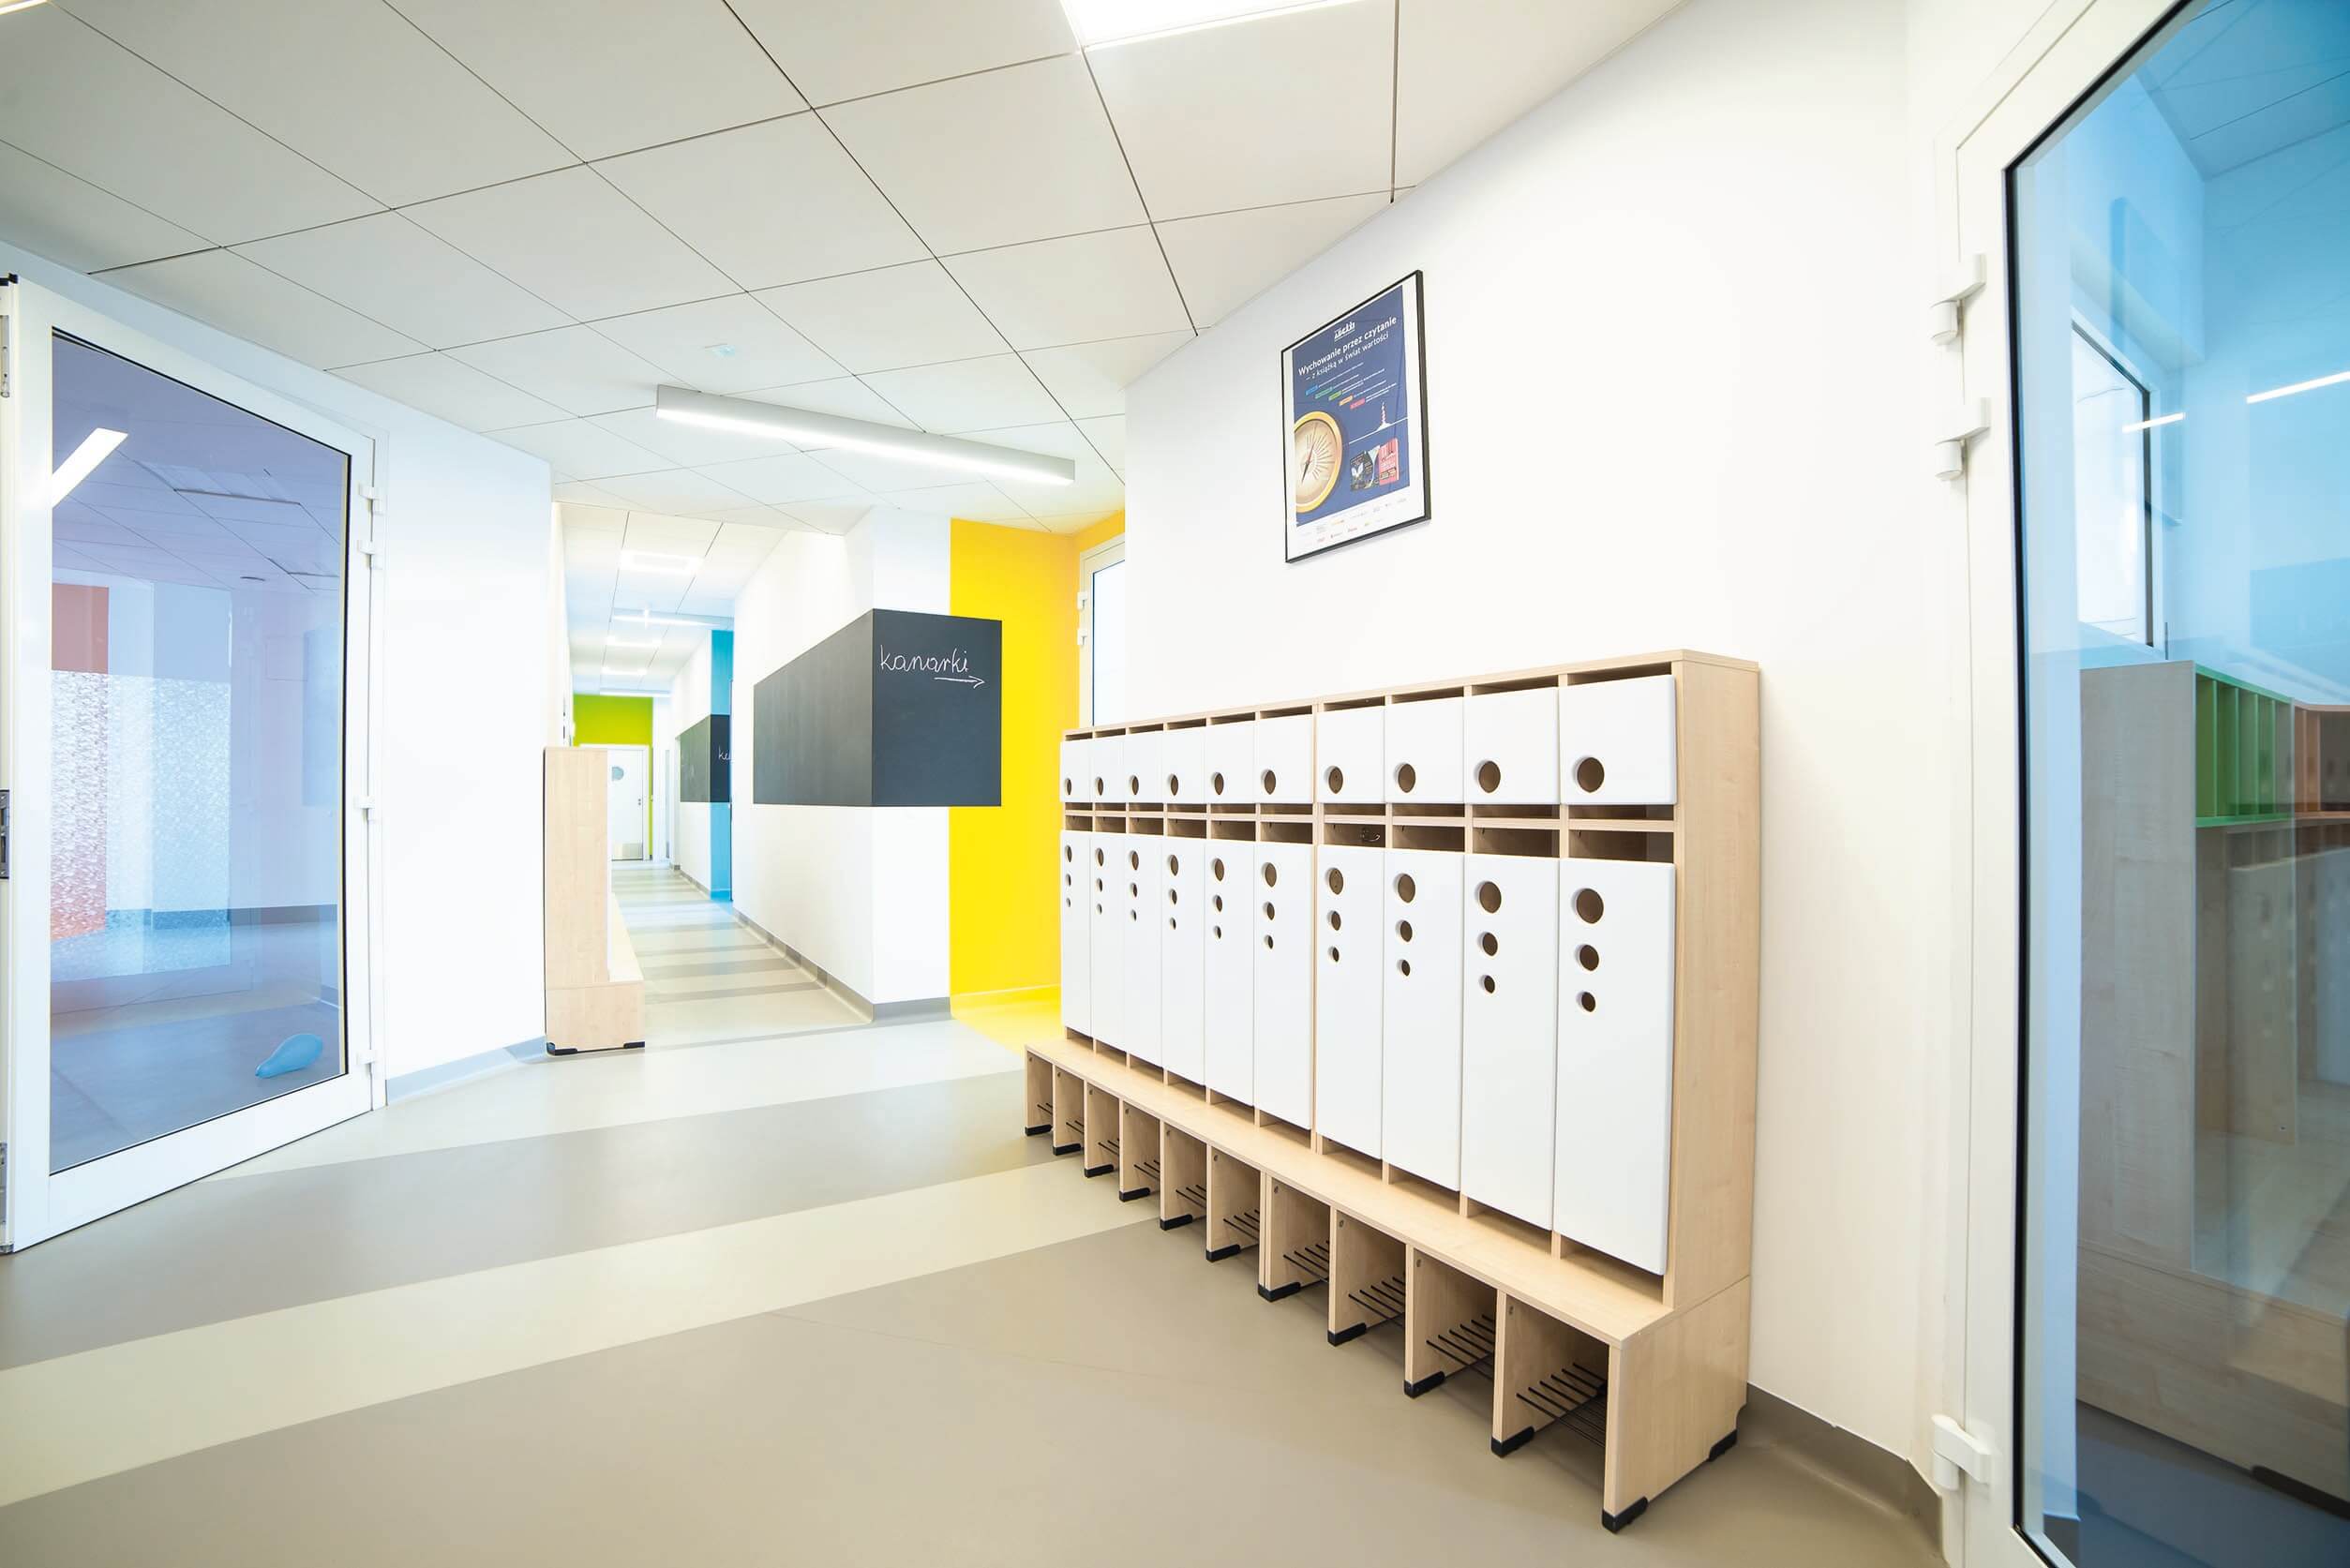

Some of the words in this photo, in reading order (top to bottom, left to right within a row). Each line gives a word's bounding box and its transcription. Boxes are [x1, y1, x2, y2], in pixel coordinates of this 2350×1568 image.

[1298, 348, 1340, 376] Wychowanie
[1342, 336, 1362, 353] przez
[1364, 317, 1397, 339] czytanie
[1344, 348, 1361, 362] świat
[1362, 331, 1389, 351] wartości
[880, 644, 969, 673] kanarki
